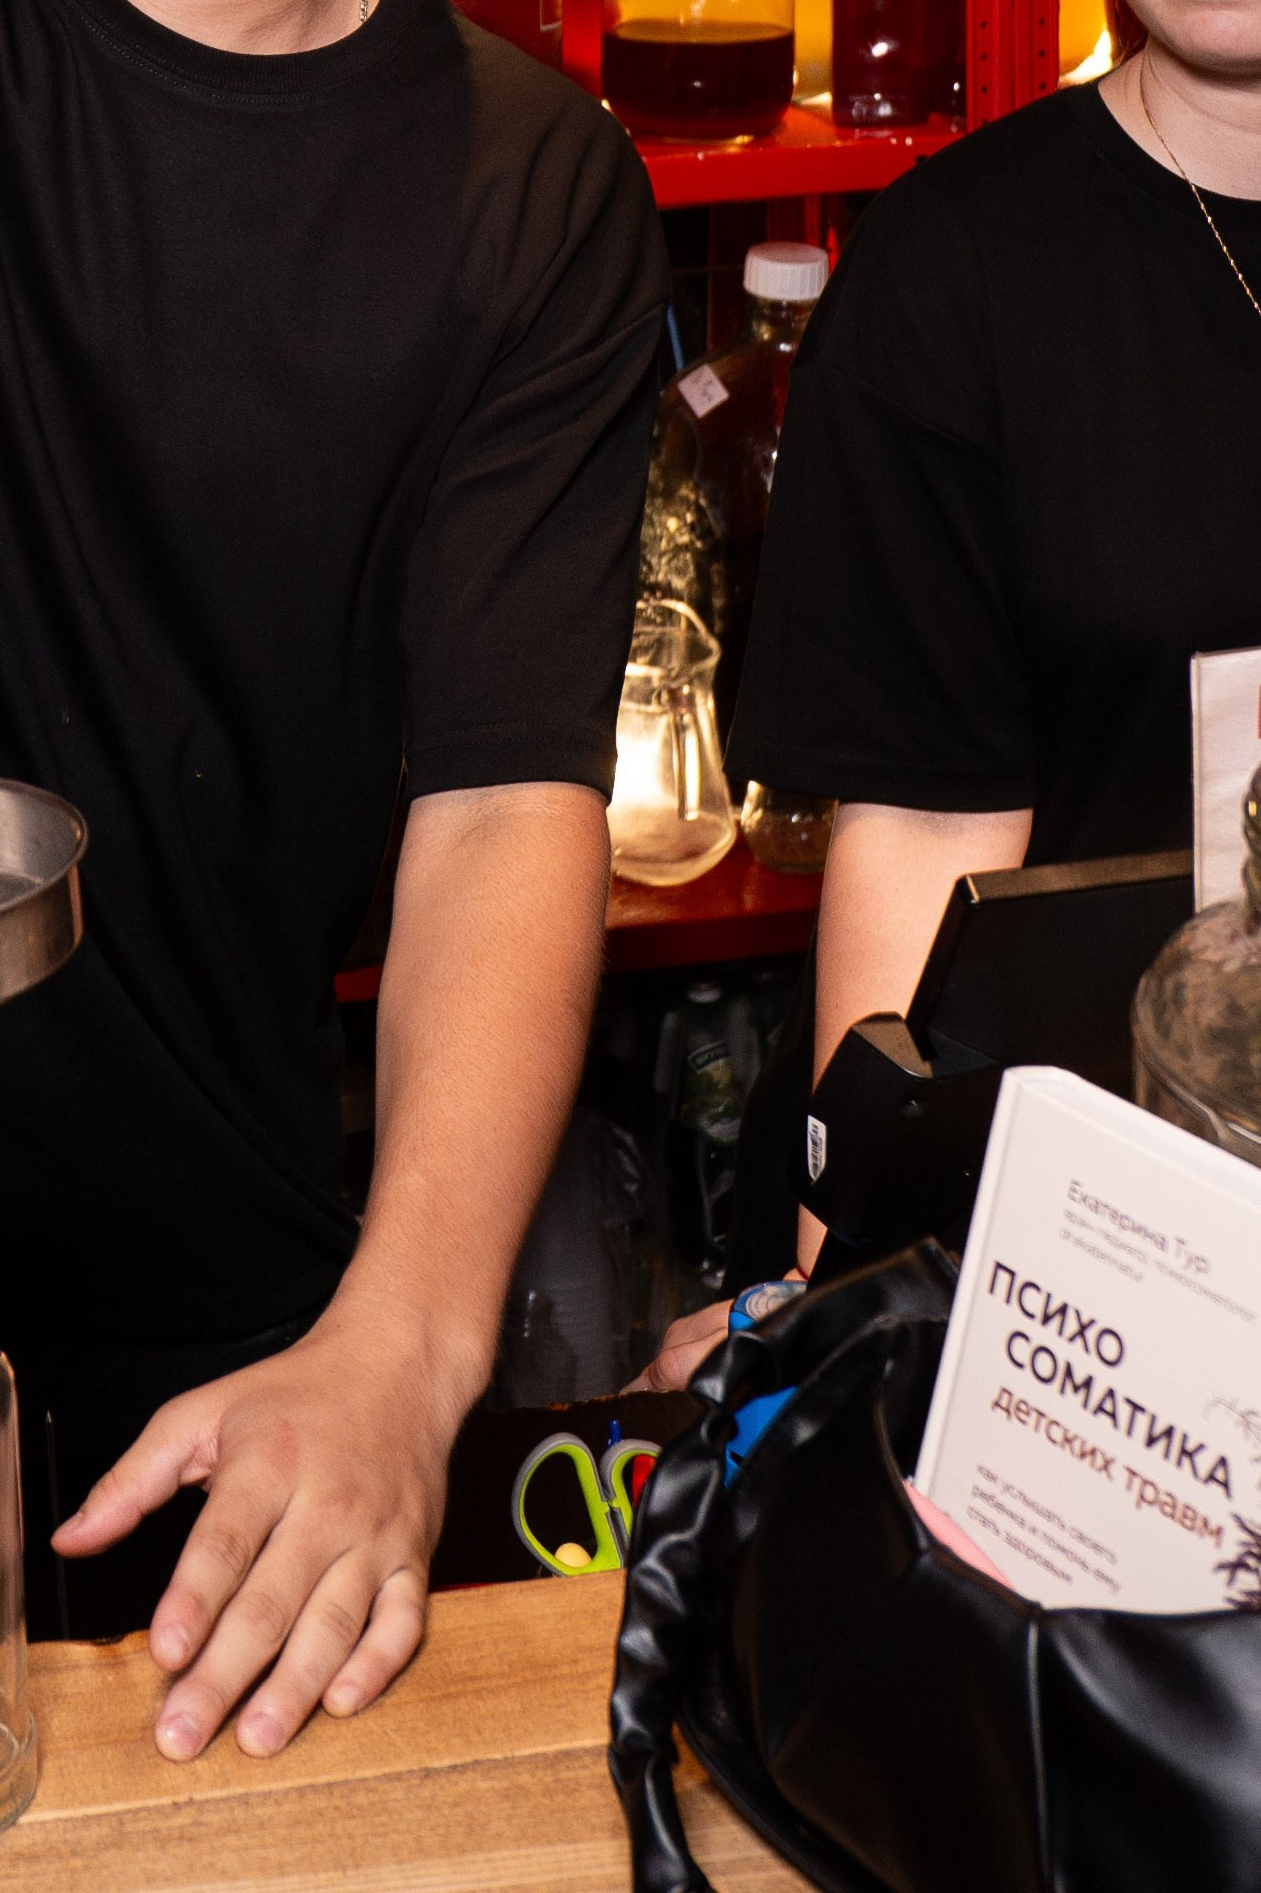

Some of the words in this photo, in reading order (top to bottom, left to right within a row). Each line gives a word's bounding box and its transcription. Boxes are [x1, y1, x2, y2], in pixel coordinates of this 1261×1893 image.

[988, 1260, 1125, 1368] ПСИХО
[992, 1386, 1116, 1481] детских
[1123, 1464, 1225, 1550] травм
[1005, 1330, 1233, 1499] СОМАТИКА
